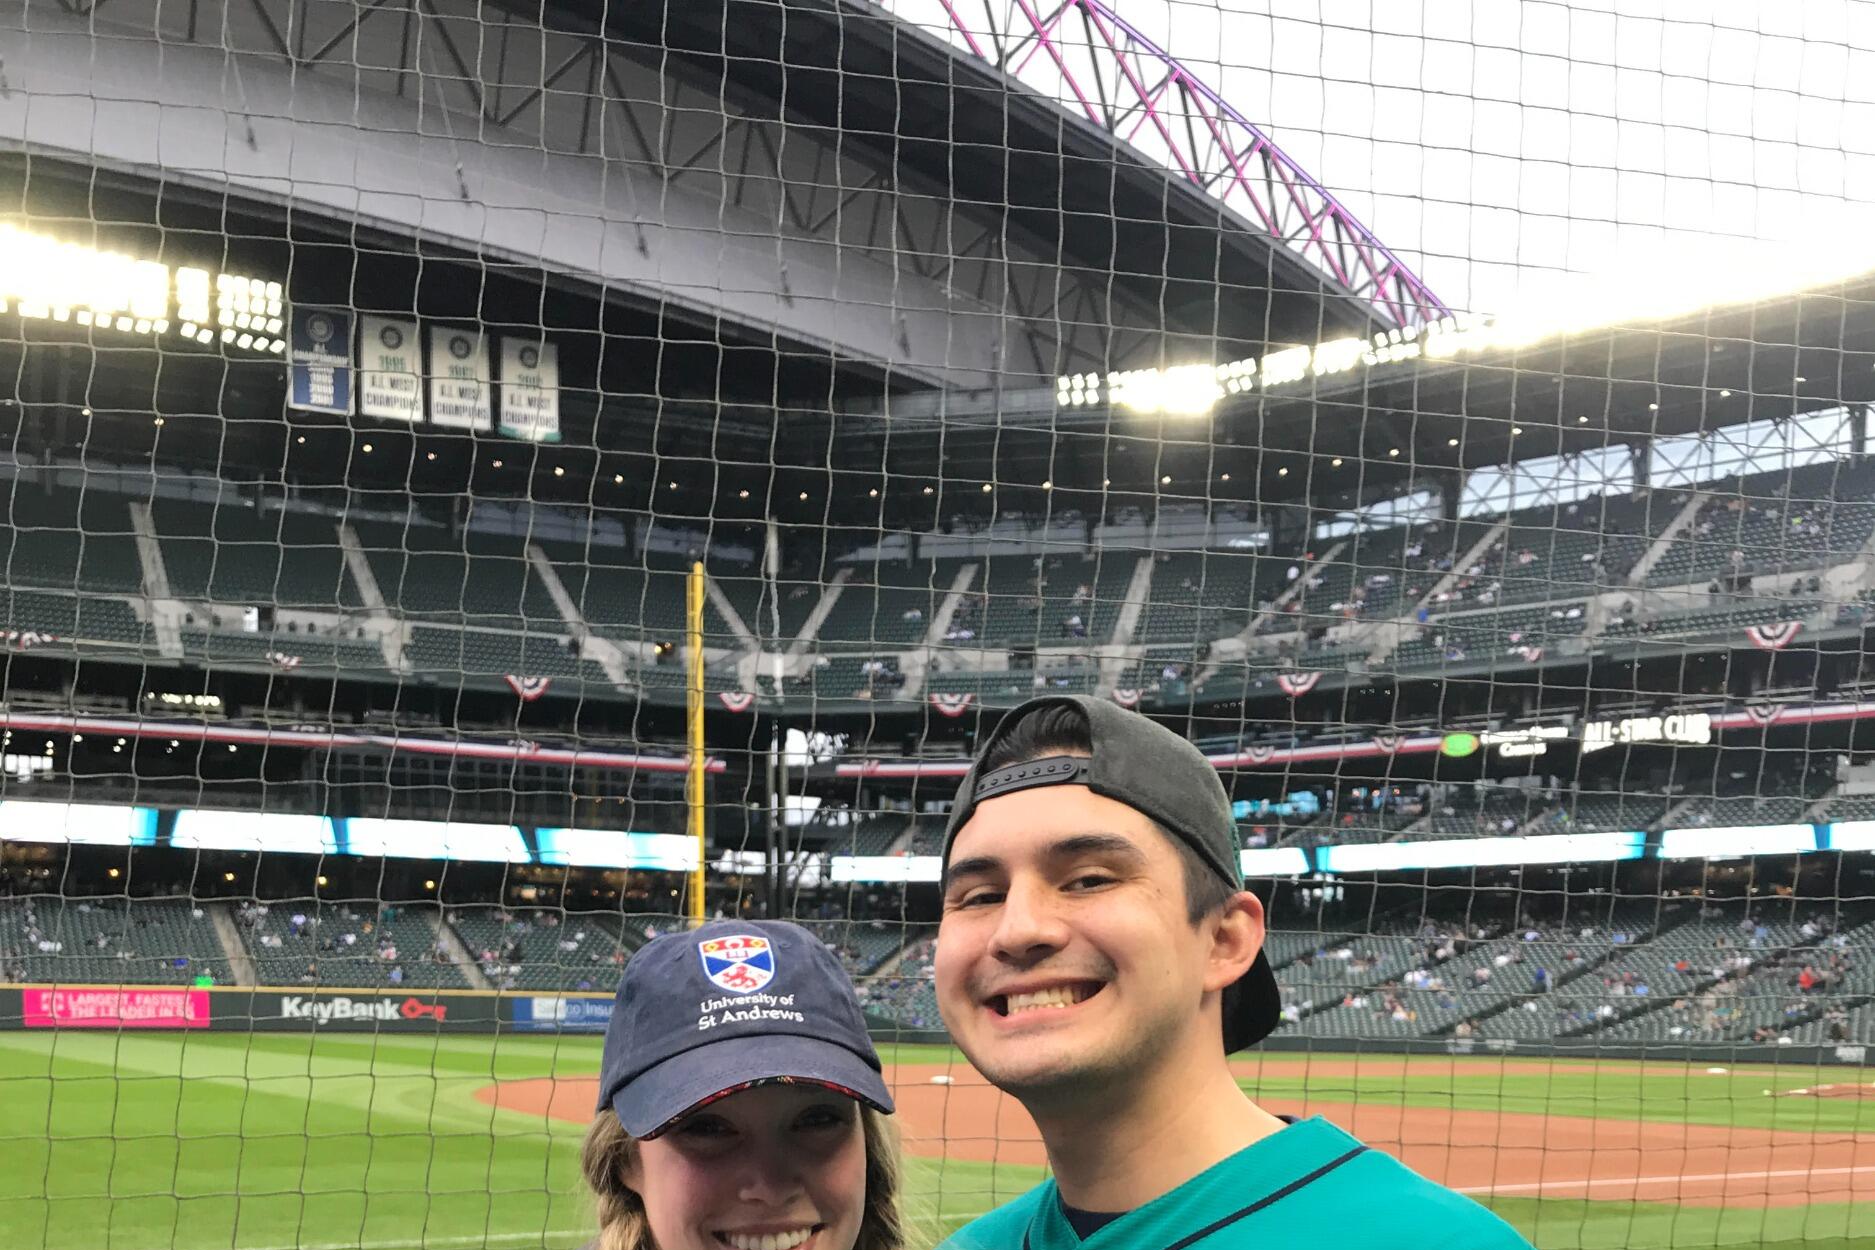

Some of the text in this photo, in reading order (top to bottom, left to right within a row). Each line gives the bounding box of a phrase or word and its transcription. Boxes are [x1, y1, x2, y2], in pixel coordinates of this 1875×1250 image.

[281, 996, 400, 1025] KeyBank
[700, 993, 795, 1013] University of
[698, 1005, 804, 1030] St Andrews
